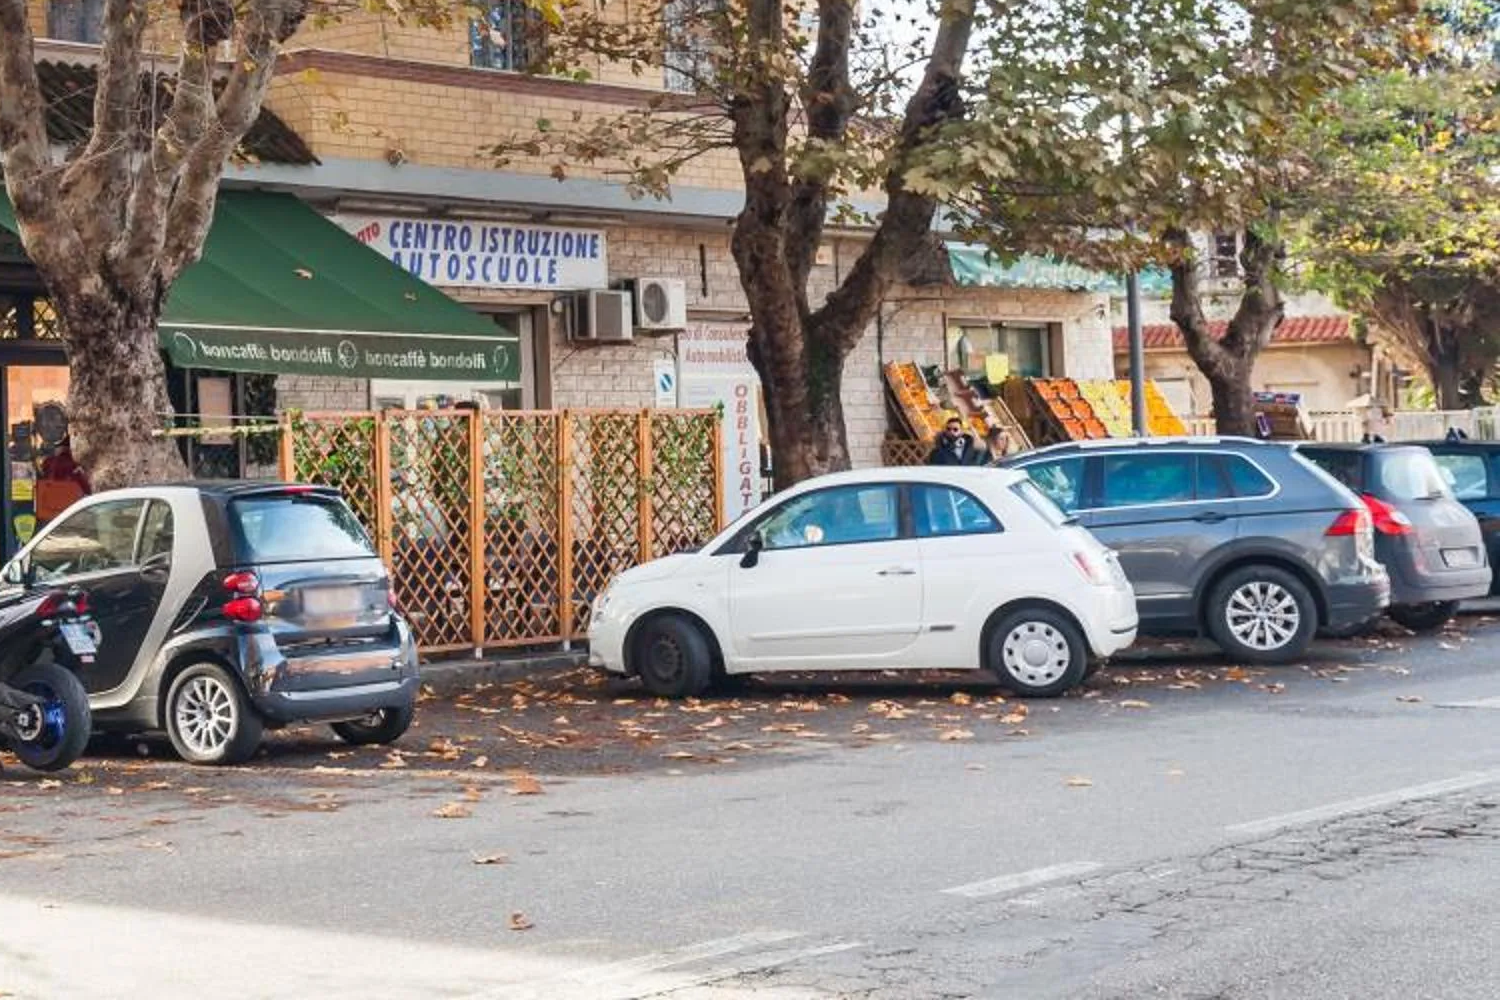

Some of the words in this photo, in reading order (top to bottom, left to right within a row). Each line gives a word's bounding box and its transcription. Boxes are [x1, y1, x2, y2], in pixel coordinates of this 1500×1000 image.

[388, 221, 472, 252] CENTRO
[480, 226, 599, 258] ISTRUZIONE
[270, 343, 332, 364] bondolfi
[364, 348, 427, 368] boncaffè
[429, 351, 486, 369] bondolfi
